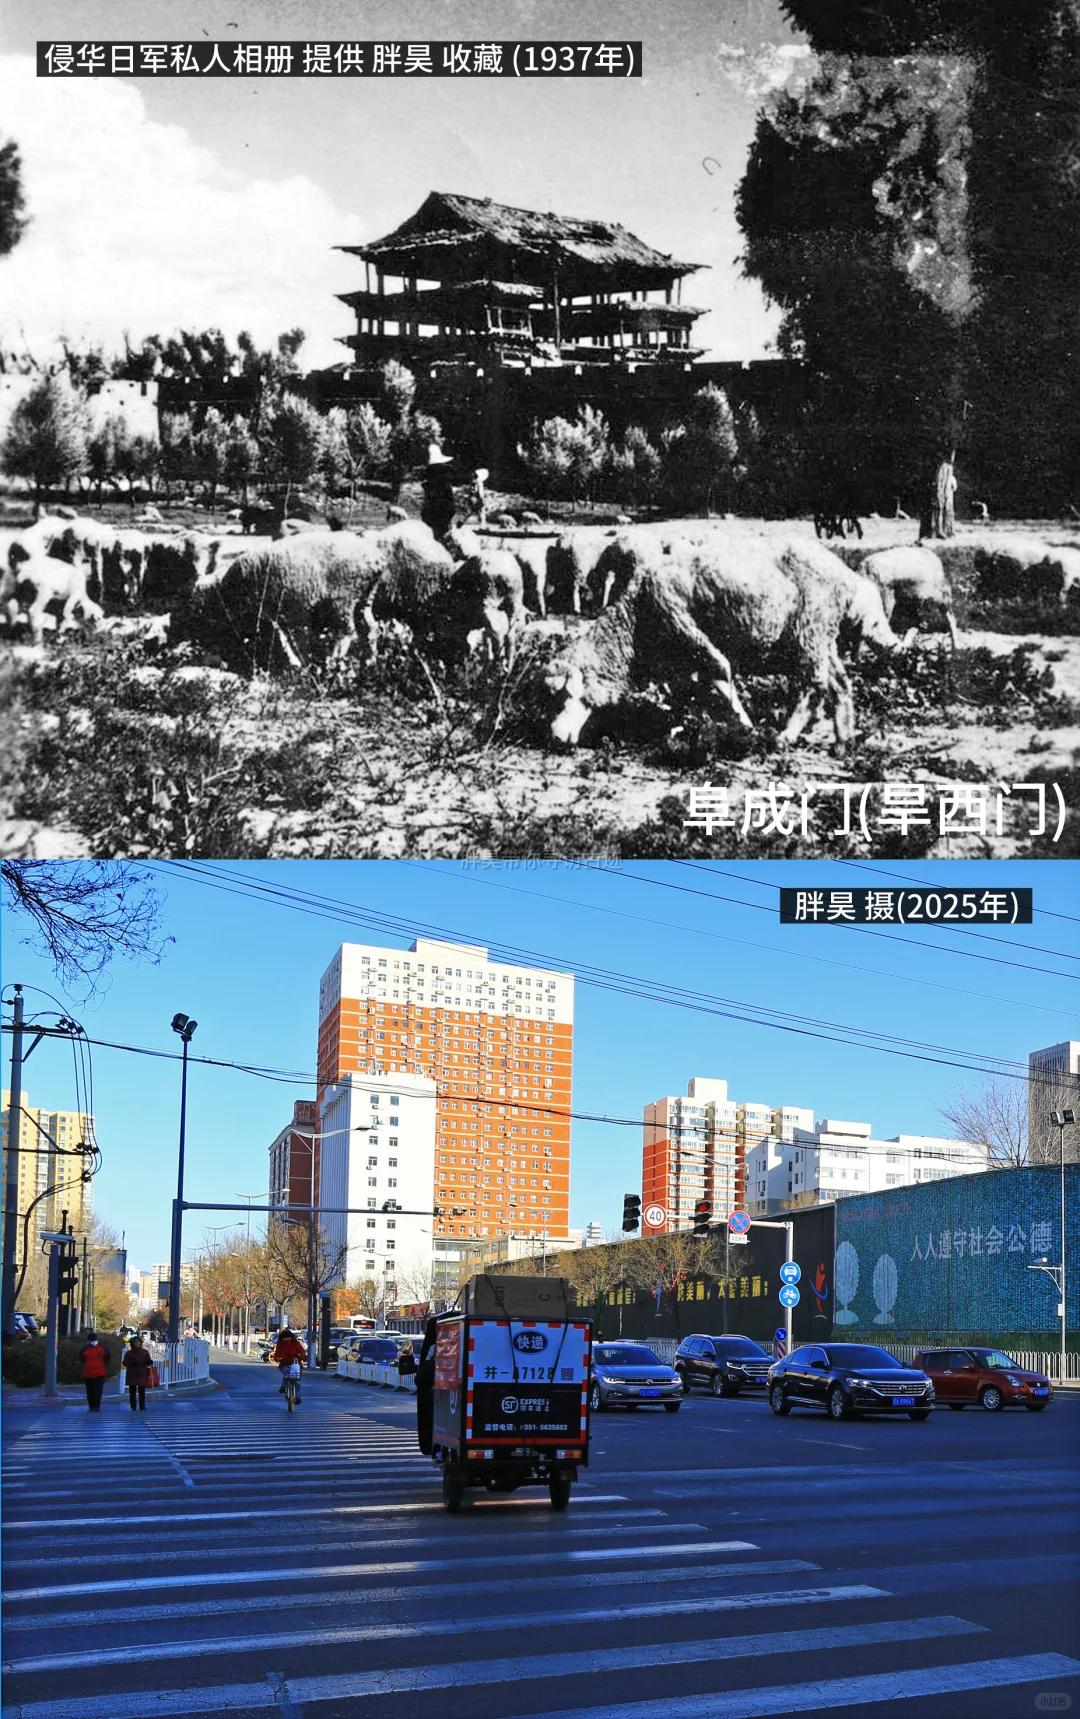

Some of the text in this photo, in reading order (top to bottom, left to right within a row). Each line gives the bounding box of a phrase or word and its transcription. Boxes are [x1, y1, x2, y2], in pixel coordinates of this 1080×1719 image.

[649, 1210, 662, 1219] 40
[911, 1221, 1053, 1261] 人人遵守社会公德
[516, 1335, 544, 1350] 快递
